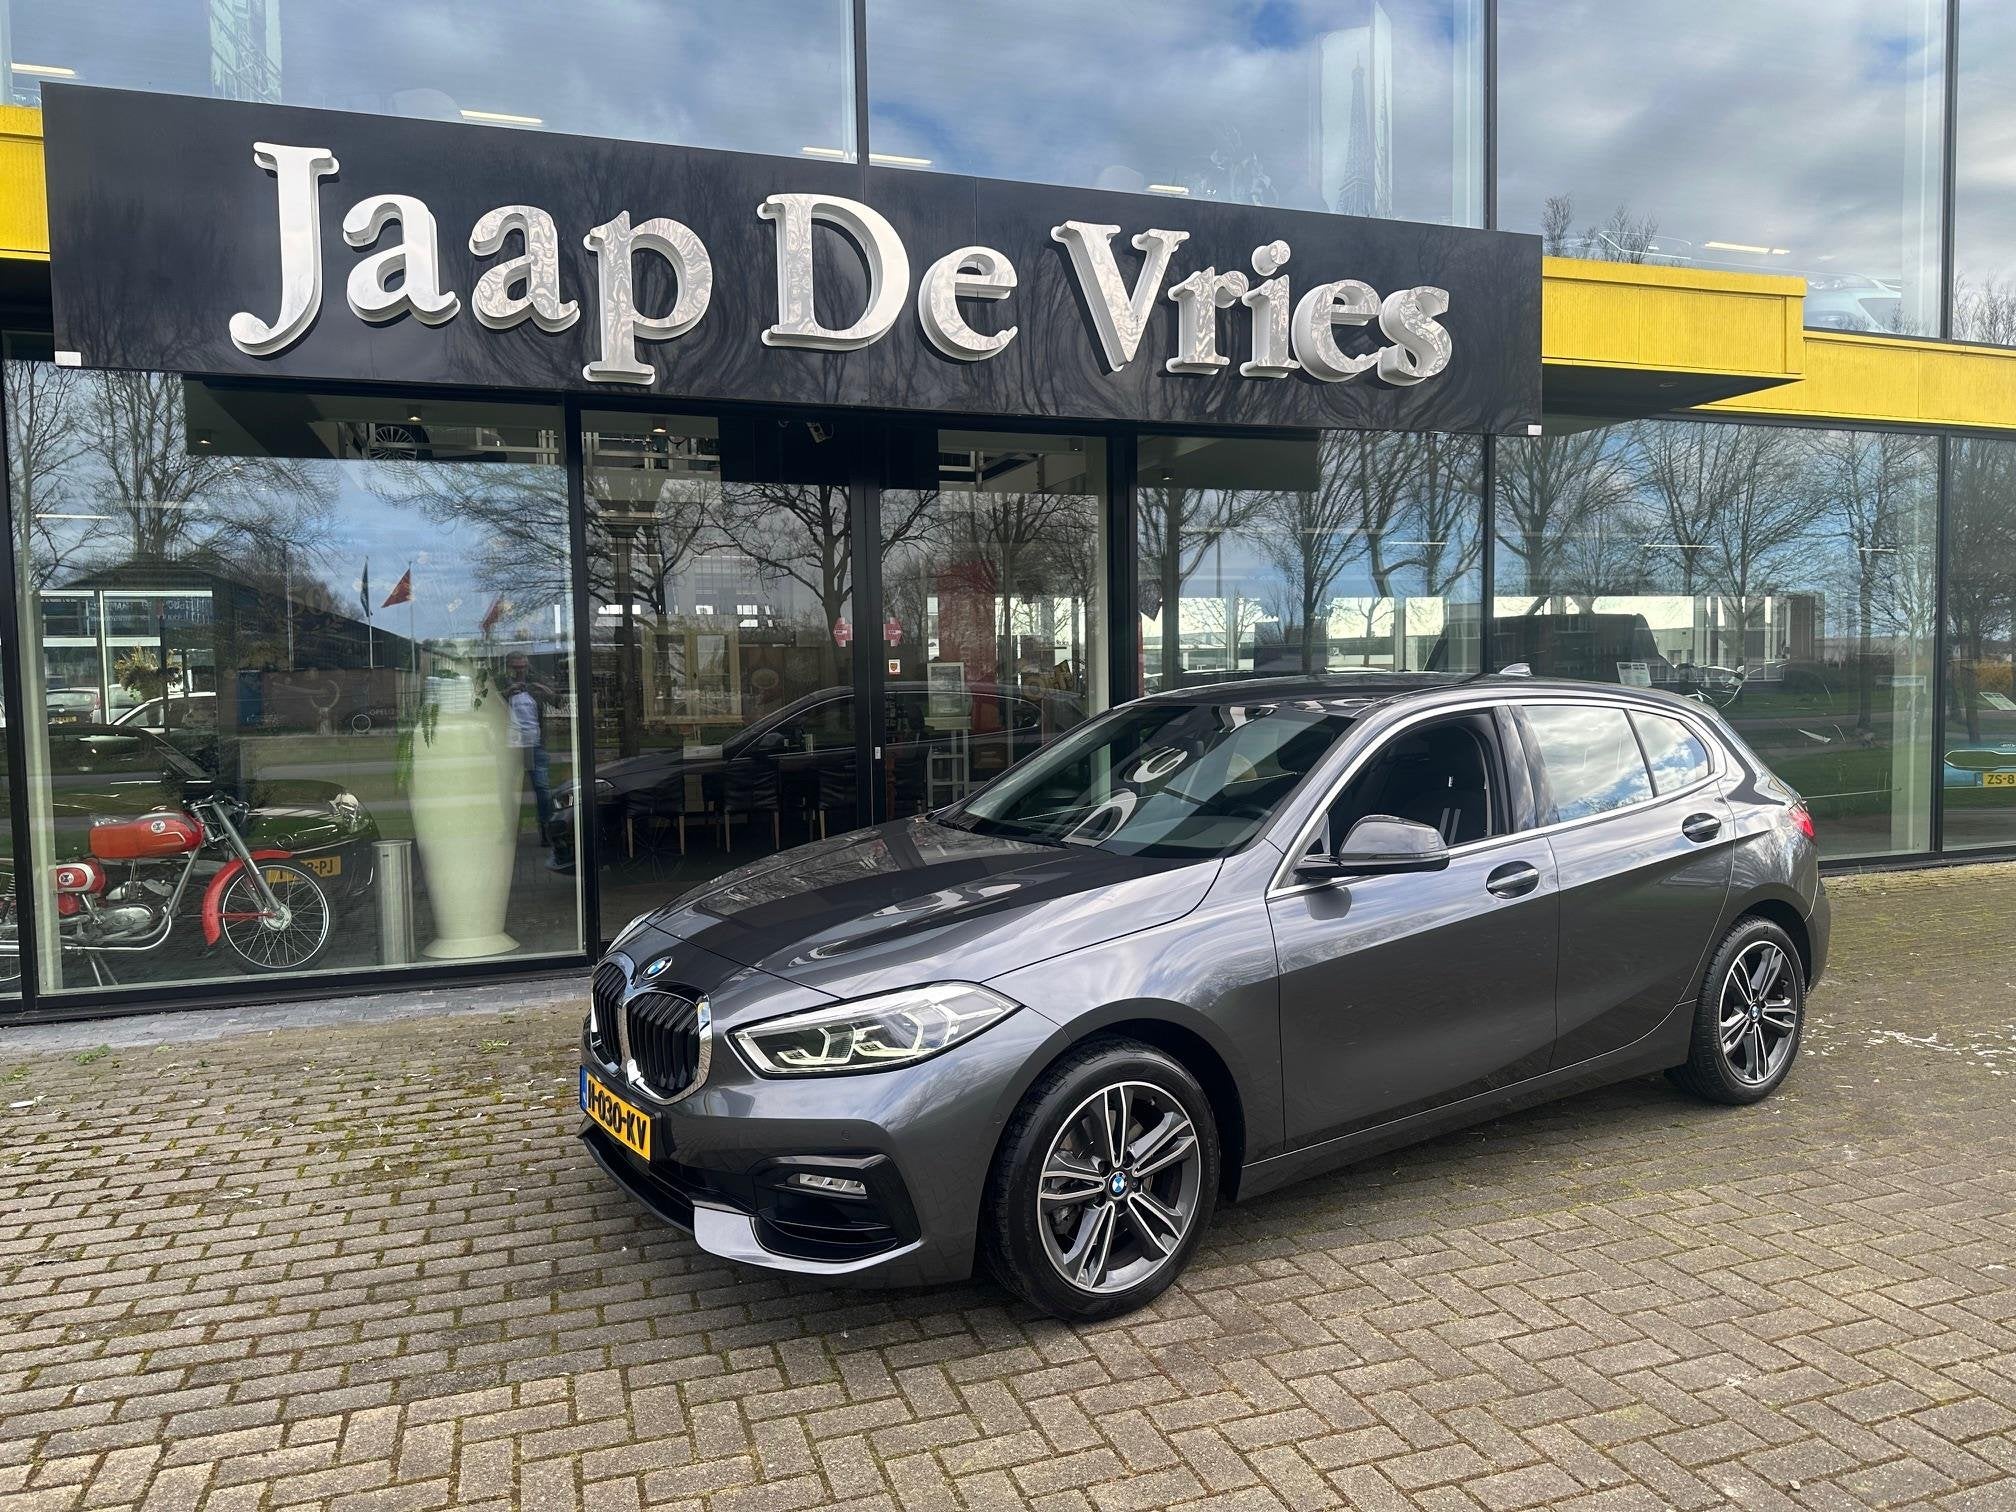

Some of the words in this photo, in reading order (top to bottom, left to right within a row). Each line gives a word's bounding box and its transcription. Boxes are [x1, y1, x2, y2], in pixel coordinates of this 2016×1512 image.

[228, 141, 713, 386] Jaap
[756, 192, 1019, 363] De
[1050, 219, 1453, 387] Vries
[1987, 774, 2015, 785] ZS-8
[587, 1079, 647, 1150] H-030-KV
